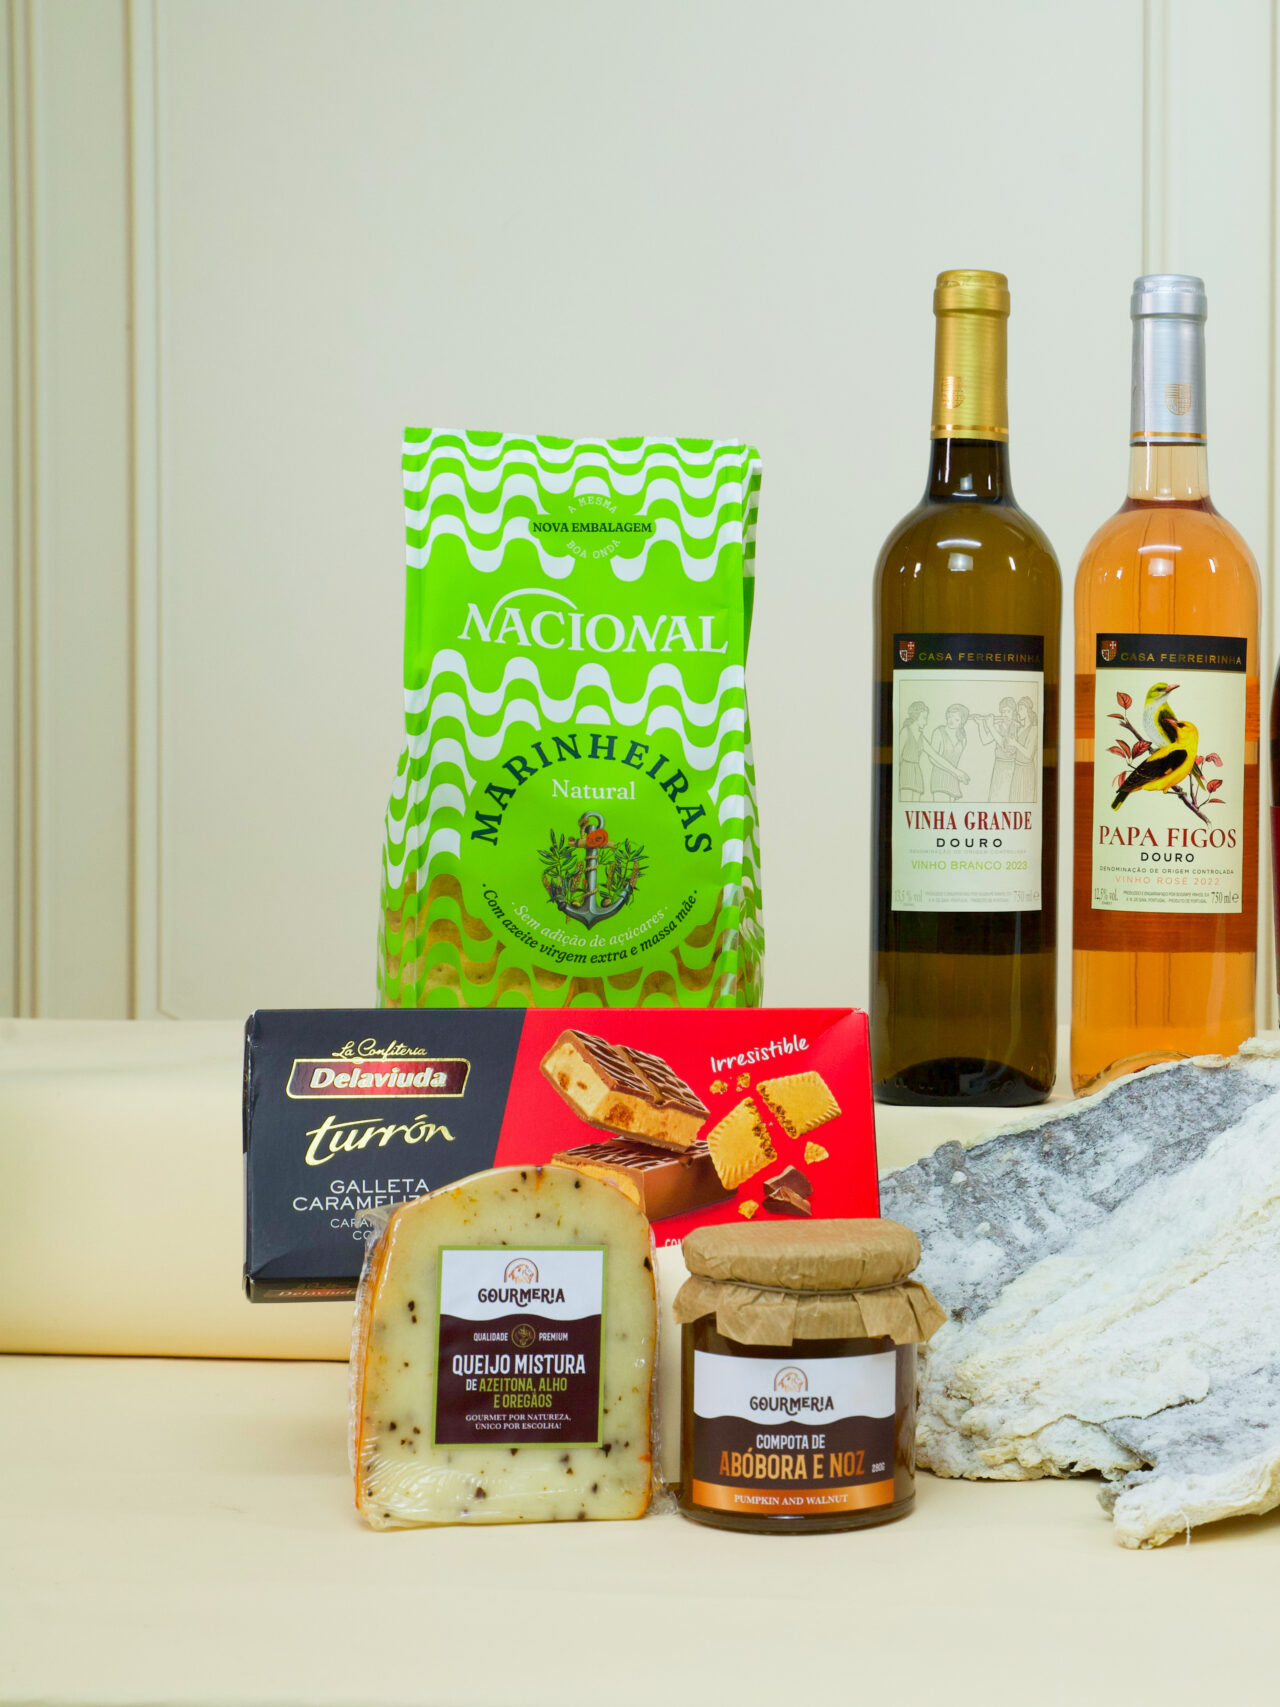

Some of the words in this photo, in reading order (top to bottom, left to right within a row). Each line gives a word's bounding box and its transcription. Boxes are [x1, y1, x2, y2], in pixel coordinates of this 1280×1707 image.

[568, 506, 577, 514] A
[578, 496, 617, 514] MESMA
[533, 522, 569, 533] NOVA
[572, 522, 652, 533] EMBALAGEM
[567, 540, 587, 559] BOA
[593, 540, 620, 559] ONDA
[457, 588, 729, 654] NACIONAL
[919, 652, 952, 662] CASA
[958, 653, 1041, 664] FERREIRINHA
[1120, 652, 1155, 662] CASA
[1160, 653, 1242, 665] FERREIRINHA
[471, 734, 713, 854] MARINHEIRAS
[552, 779, 636, 800] Natural
[905, 811, 957, 831] VINHA
[964, 811, 1032, 831] GRANDE
[936, 838, 1003, 848] DOURO
[1099, 825, 1158, 847] PAPA
[1167, 828, 1237, 849] FIGOS
[911, 861, 947, 871] VINHO
[950, 861, 1002, 871] BRANCO
[1006, 861, 1028, 871] 2023
[1140, 852, 1195, 862] DOURO
[1115, 876, 1151, 885] VINHO
[1193, 878, 1221, 886] 2022
[483, 889, 505, 919] Com
[502, 918, 538, 948] azeite
[540, 944, 587, 964] virgem
[590, 951, 628, 964] extra
[631, 947, 639, 955] e
[640, 921, 677, 952] massa
[677, 895, 697, 922] mãe
[514, 905, 541, 931] Sem
[541, 929, 587, 948] adição
[589, 935, 606, 948] de
[610, 912, 665, 946] açúcares
[332, 1041, 356, 1059] La
[711, 1034, 809, 1073] Irresistible
[310, 1067, 448, 1089] Delaviuda
[305, 1114, 456, 1166] turrón
[330, 1179, 430, 1194] GALLETA
[478, 1288, 566, 1308] GOURMERIA
[474, 1332, 509, 1342] QUALIDADE
[539, 1332, 569, 1341] PREMIUM
[452, 1354, 511, 1375] QUEIJO
[515, 1354, 586, 1375] MISTURA
[466, 1379, 478, 1391] DE
[479, 1378, 537, 1394] AZEITONA,
[539, 1377, 568, 1392] ALHO
[494, 1394, 501, 1408] E
[750, 1396, 835, 1416] GOURMERIA
[466, 1414, 508, 1422] GOURMET
[527, 1414, 572, 1422] NATUREZA,
[756, 1434, 810, 1450] COMPOTA
[812, 1434, 826, 1449] DE
[720, 1447, 808, 1480] ABÓBORA
[813, 1454, 824, 1479] E
[830, 1450, 866, 1478] NOZ
[734, 1494, 780, 1506] PUMPKIN
[782, 1497, 805, 1506] AND
[806, 1494, 849, 1505] WALNUT
